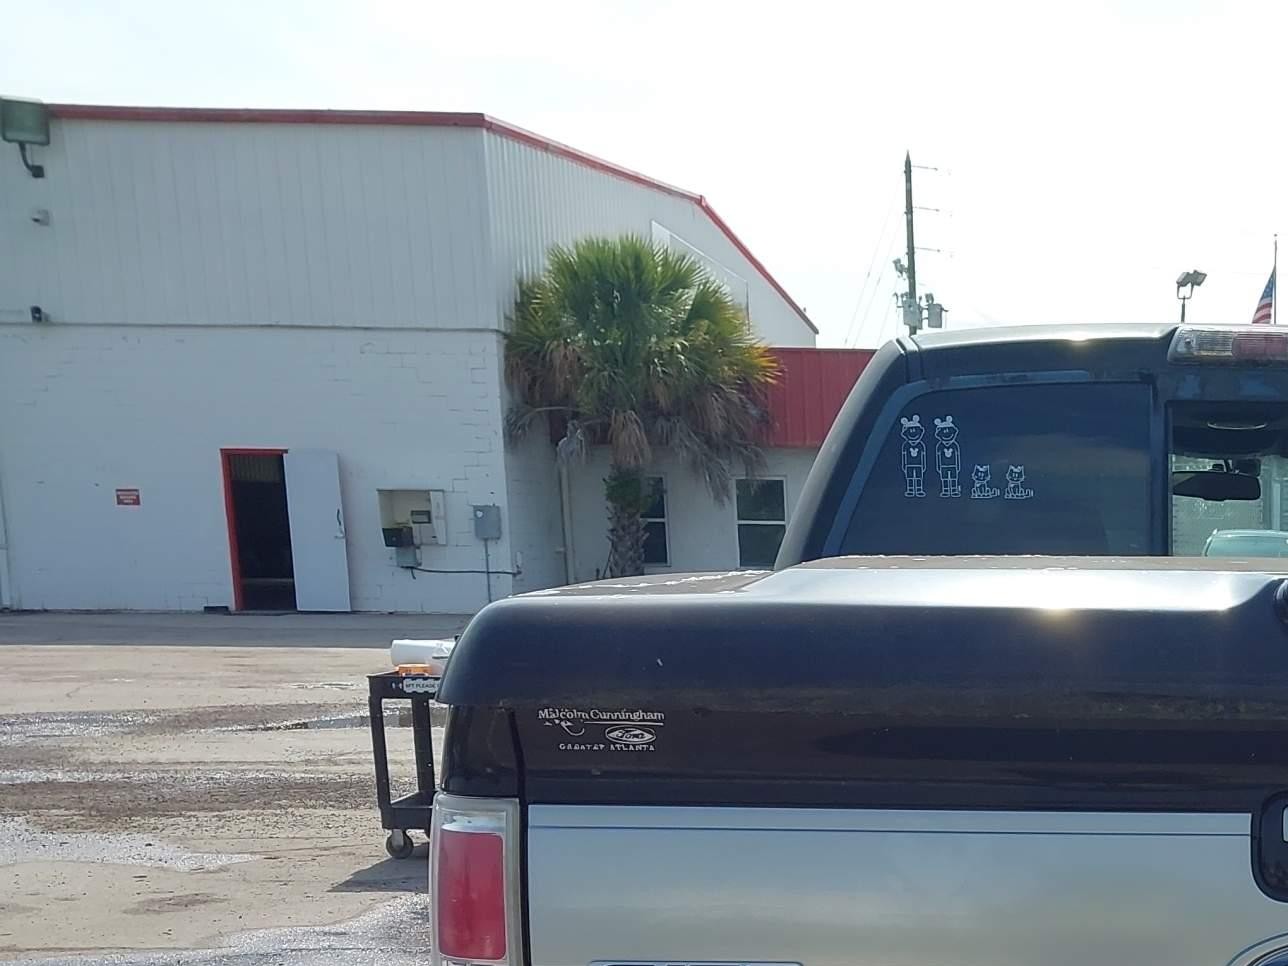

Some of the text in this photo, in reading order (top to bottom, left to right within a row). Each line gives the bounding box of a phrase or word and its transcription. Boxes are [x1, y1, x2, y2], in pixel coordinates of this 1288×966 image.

[538, 707, 665, 722] Malcolm Cunningham
[610, 744, 655, 752] ATLANTA
